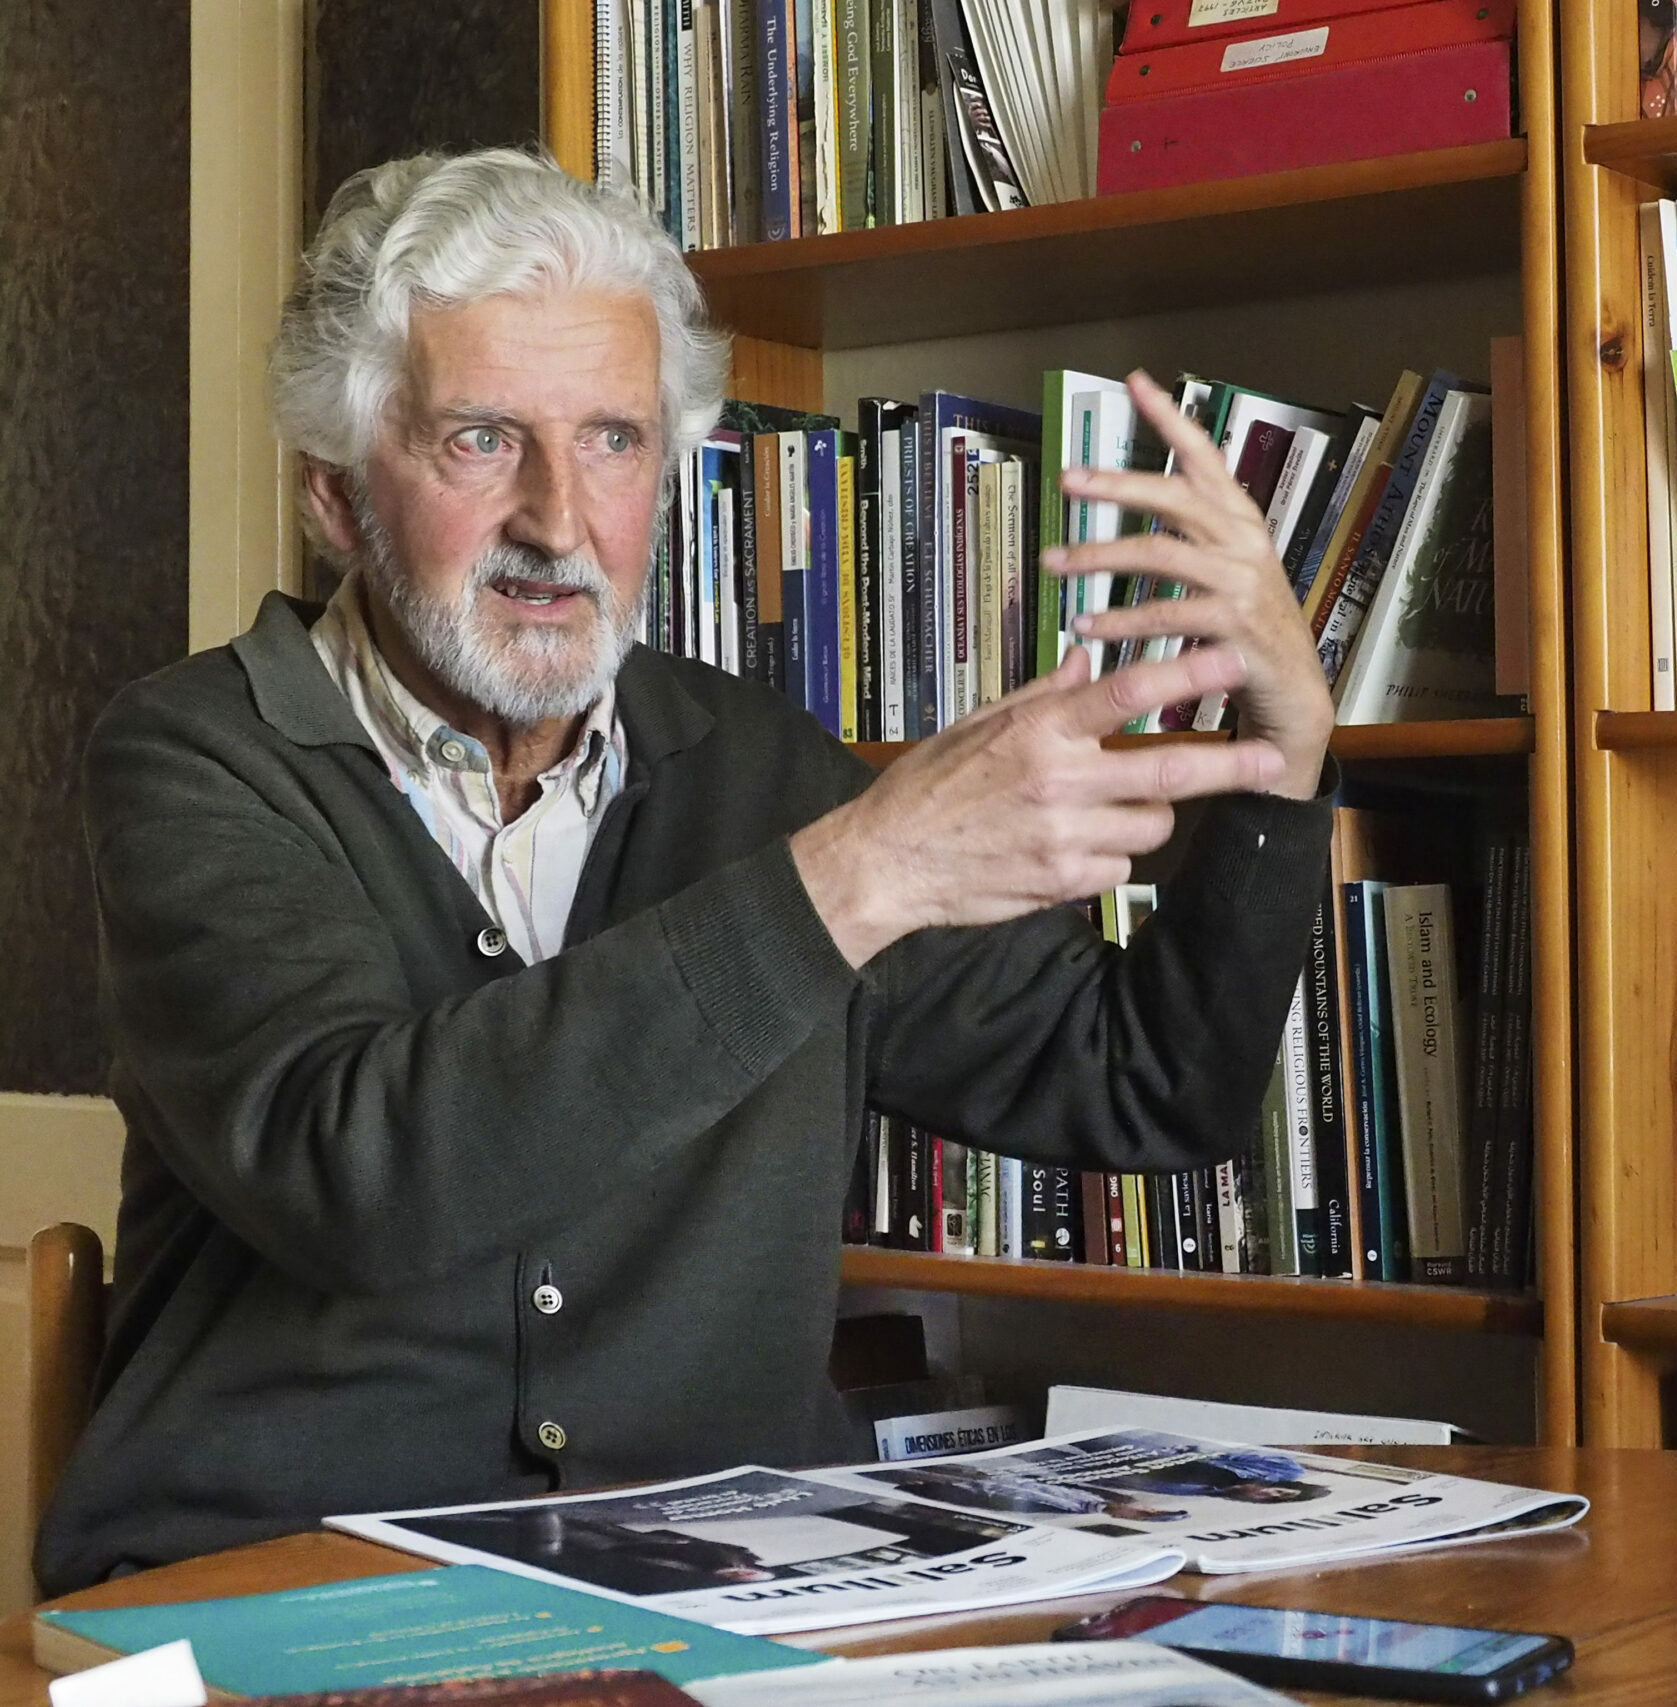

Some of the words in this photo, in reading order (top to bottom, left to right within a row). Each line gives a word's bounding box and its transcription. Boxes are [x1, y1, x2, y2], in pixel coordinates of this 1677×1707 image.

[766, 16, 776, 44] The
[846, 31, 858, 62] God
[1258, 39, 1295, 52] POLICY
[682, 42, 692, 78] WHY
[765, 49, 778, 128] Underlying
[683, 86, 694, 155] RELIGION
[846, 66, 859, 152] Everywhere
[768, 131, 780, 193] Religion
[686, 163, 696, 232] MATTERS
[1646, 255, 1655, 285] Cuidem
[1648, 288, 1655, 300] la
[1648, 301, 1657, 327] Terra
[1400, 392, 1444, 477] MOUNT
[859, 439, 867, 470] Smith
[903, 436, 914, 496] PRIESTS
[923, 461, 934, 522] BELIEVE
[966, 463, 979, 496] 252
[1008, 484, 1018, 502] The
[904, 498, 914, 518] OF
[1412, 492, 1424, 511] Rape
[743, 488, 755, 577] SACRAMENT
[859, 499, 868, 551] Beyond
[954, 508, 964, 552] INDÍGENAS
[1007, 504, 1018, 548] Sermon
[1352, 531, 1361, 542] IL
[1363, 481, 1404, 559] ATHOS
[1404, 518, 1415, 534] Man
[904, 521, 915, 594] CREATION
[1007, 550, 1018, 561] of
[1007, 561, 1018, 574] all
[1334, 545, 1355, 588] SANTO
[1391, 546, 1404, 569] Nature
[746, 579, 755, 593] AS
[861, 576, 870, 664] Post-Modern
[924, 569, 935, 674] SCHUMACHER
[955, 599, 965, 615] SUS
[746, 596, 757, 669] CREATION
[955, 620, 965, 659] OCEANÍA
[1330, 619, 1341, 632] in
[862, 665, 871, 699] Mind
[956, 669, 965, 716] CONCILIUM
[1349, 895, 1358, 903] 21
[1419, 911, 1433, 953] Islam
[1313, 937, 1329, 1019] MOUNTAINS
[1421, 959, 1435, 989] and
[1317, 1020, 1330, 1041] OF
[1422, 995, 1438, 1059] Ecology
[1292, 1026, 1307, 1104] RELIGIOUS
[1318, 1042, 1331, 1071] THE
[1320, 1072, 1334, 1123] WORLD
[1362, 1101, 1371, 1148] conservación
[911, 1151, 919, 1191] Hamilton
[1109, 1176, 1118, 1198] ONG
[1181, 1171, 1191, 1203] saviesa
[1219, 1165, 1230, 1187] MA
[1032, 1169, 1046, 1213] Soul
[1055, 1167, 1069, 1217] PATH
[1221, 1190, 1231, 1207] LA
[1182, 1204, 1192, 1217] La
[1328, 1198, 1343, 1255] California
[1114, 1243, 1121, 1253] 6
[1426, 1267, 1453, 1277] CSWR
[904, 1430, 955, 1454] DIMENSIONES
[957, 1426, 986, 1447] ÉTICAS
[987, 1426, 1000, 1443] EN
